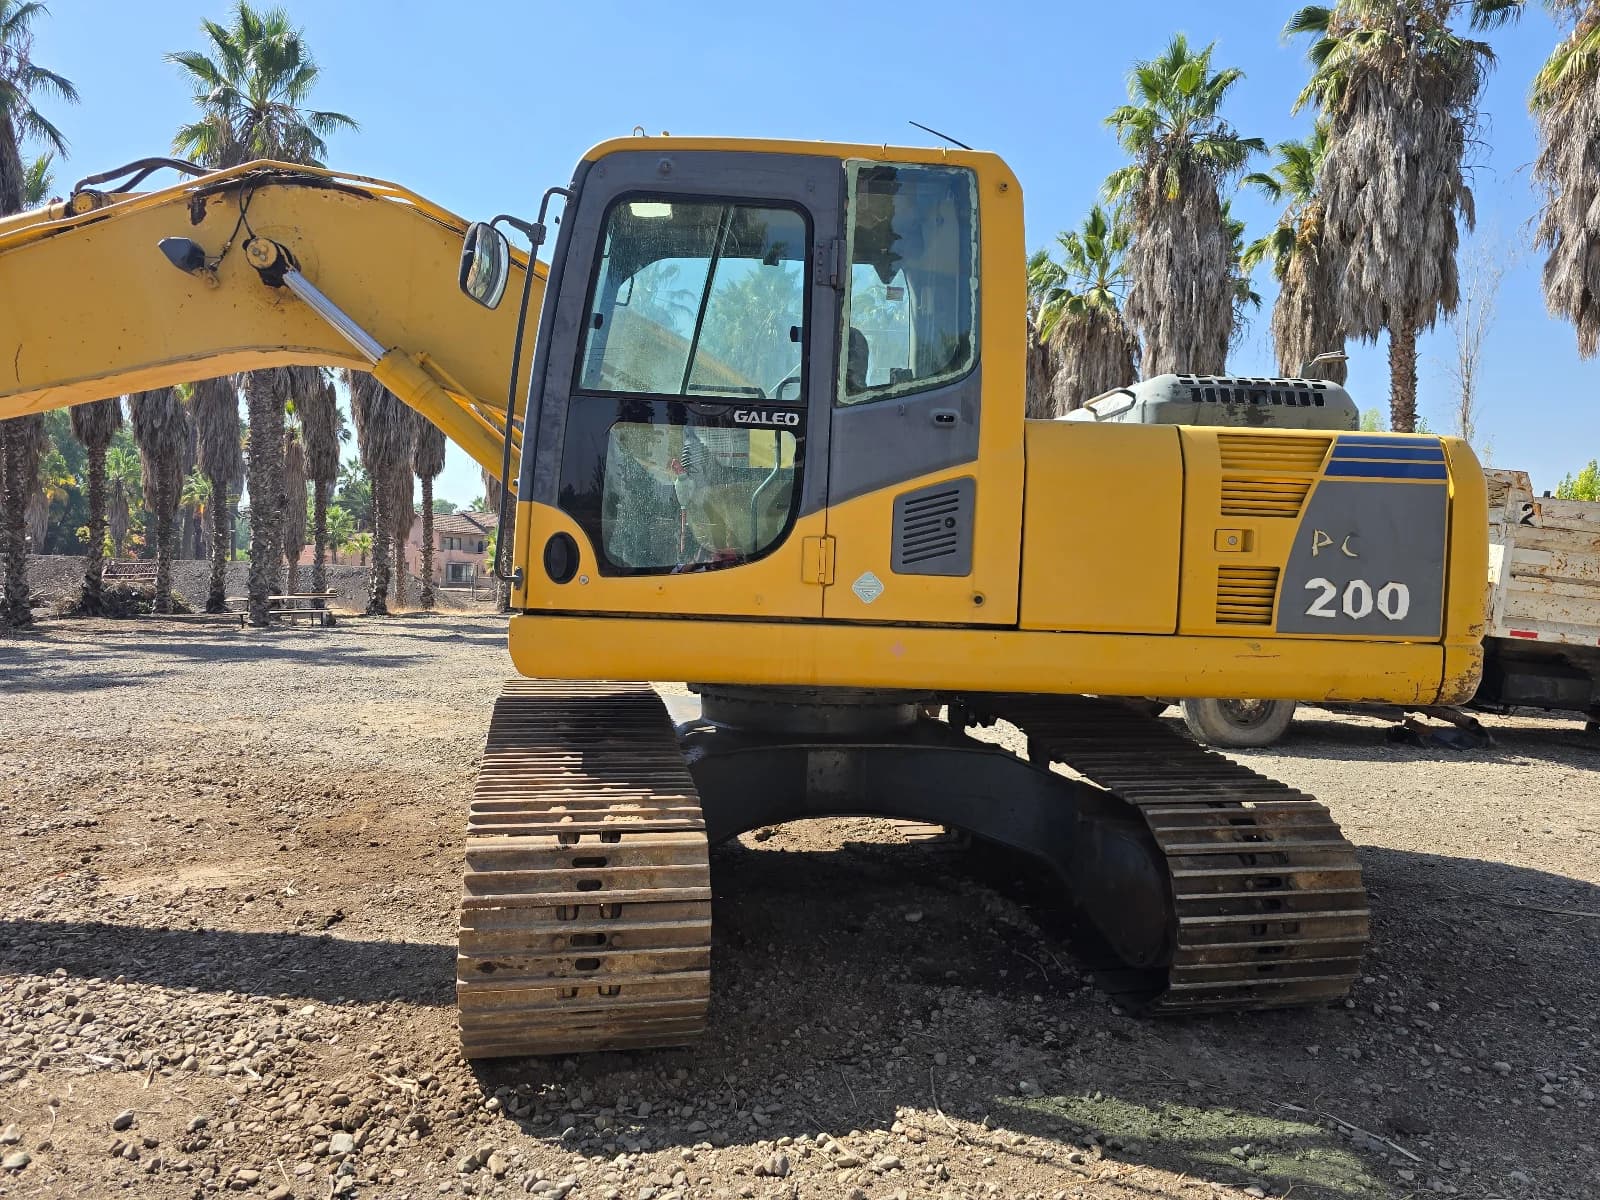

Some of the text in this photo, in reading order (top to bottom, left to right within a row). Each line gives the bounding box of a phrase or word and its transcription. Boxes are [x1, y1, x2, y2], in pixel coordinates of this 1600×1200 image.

[733, 410, 800, 426] GALEO
[1520, 503, 1535, 527] 2
[1304, 577, 1410, 621] 200
